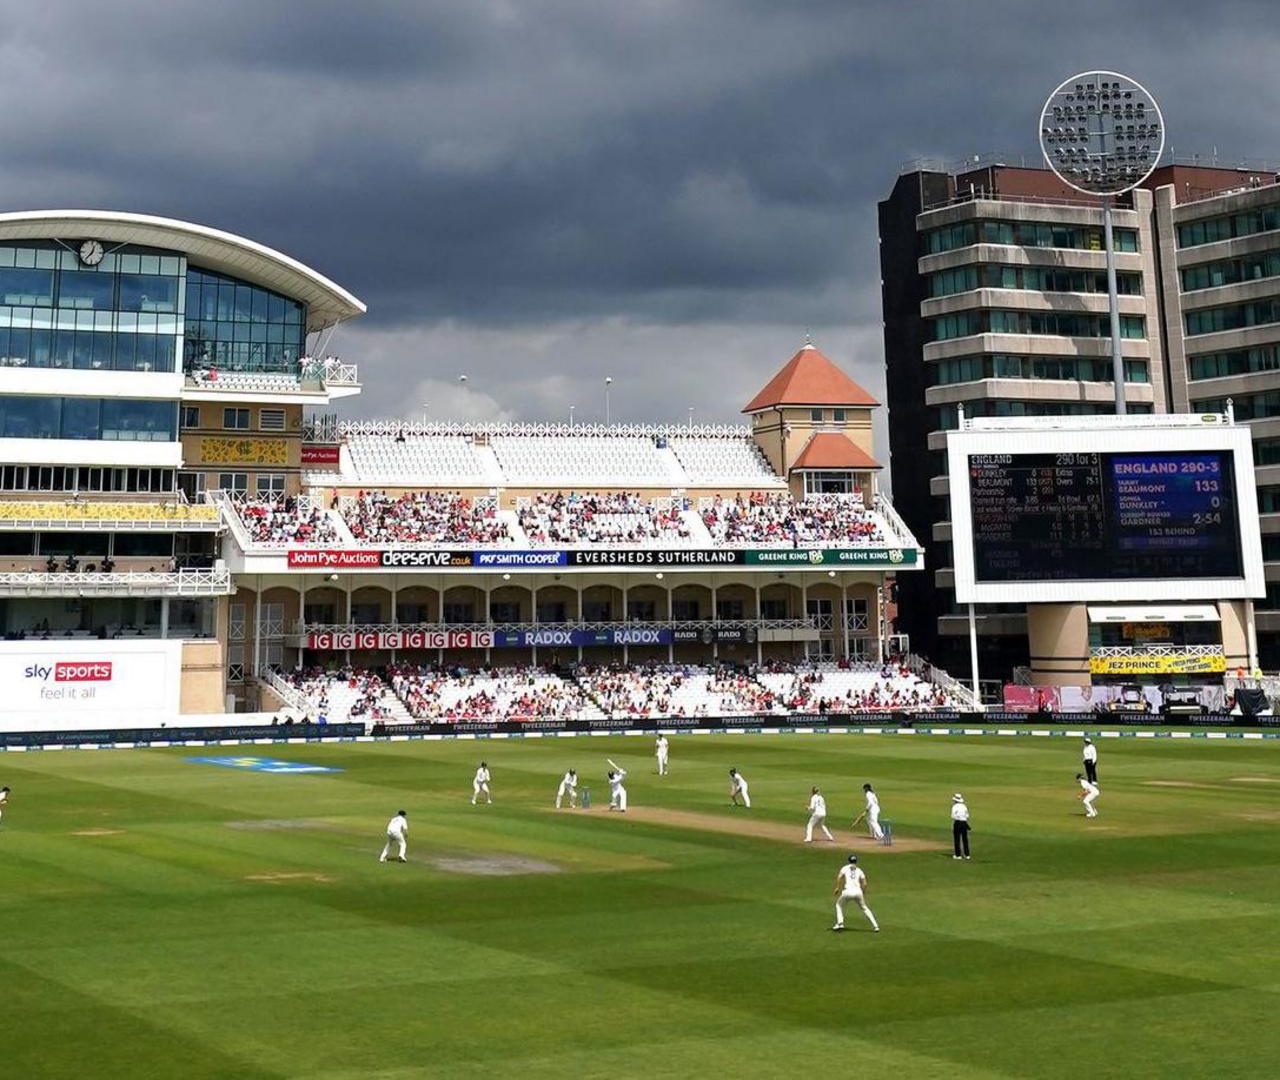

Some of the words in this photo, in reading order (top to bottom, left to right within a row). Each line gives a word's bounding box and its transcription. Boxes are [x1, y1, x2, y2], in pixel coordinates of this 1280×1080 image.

[971, 455, 1012, 464] ENGLAND
[1056, 454, 1074, 464] 290
[1091, 453, 1098, 464] 3
[1115, 464, 1177, 473] ENGLAND
[1181, 462, 1219, 473] 290-3
[1118, 485, 1165, 493] BEAUMONT
[1195, 480, 1218, 491] 133
[1119, 501, 1157, 509] DUNKLEY
[1211, 497, 1220, 507] 0
[1193, 513, 1220, 524] 2-54
[291, 553, 317, 563] John
[319, 553, 338, 565] Pye
[339, 553, 378, 564] Auctions
[497, 554, 523, 563] SMITH
[525, 554, 558, 563] COOPER
[576, 552, 653, 563] EVERSHEDS
[658, 552, 735, 563] SUTHERLAND
[314, 635, 329, 648] IG
[337, 635, 352, 648] IG
[359, 634, 375, 648] IG
[383, 634, 398, 647] IG
[407, 634, 421, 647] IG
[430, 634, 445, 647] IG
[452, 634, 467, 647] IG
[476, 634, 491, 646] IG
[525, 633, 572, 644] RADOX
[614, 632, 659, 643] RADOX
[1108, 661, 1124, 669] JEZ
[25, 664, 52, 680] sky
[58, 665, 110, 680] sports
[40, 687, 64, 699] feel
[68, 688, 76, 699] it
[81, 688, 96, 698] all
